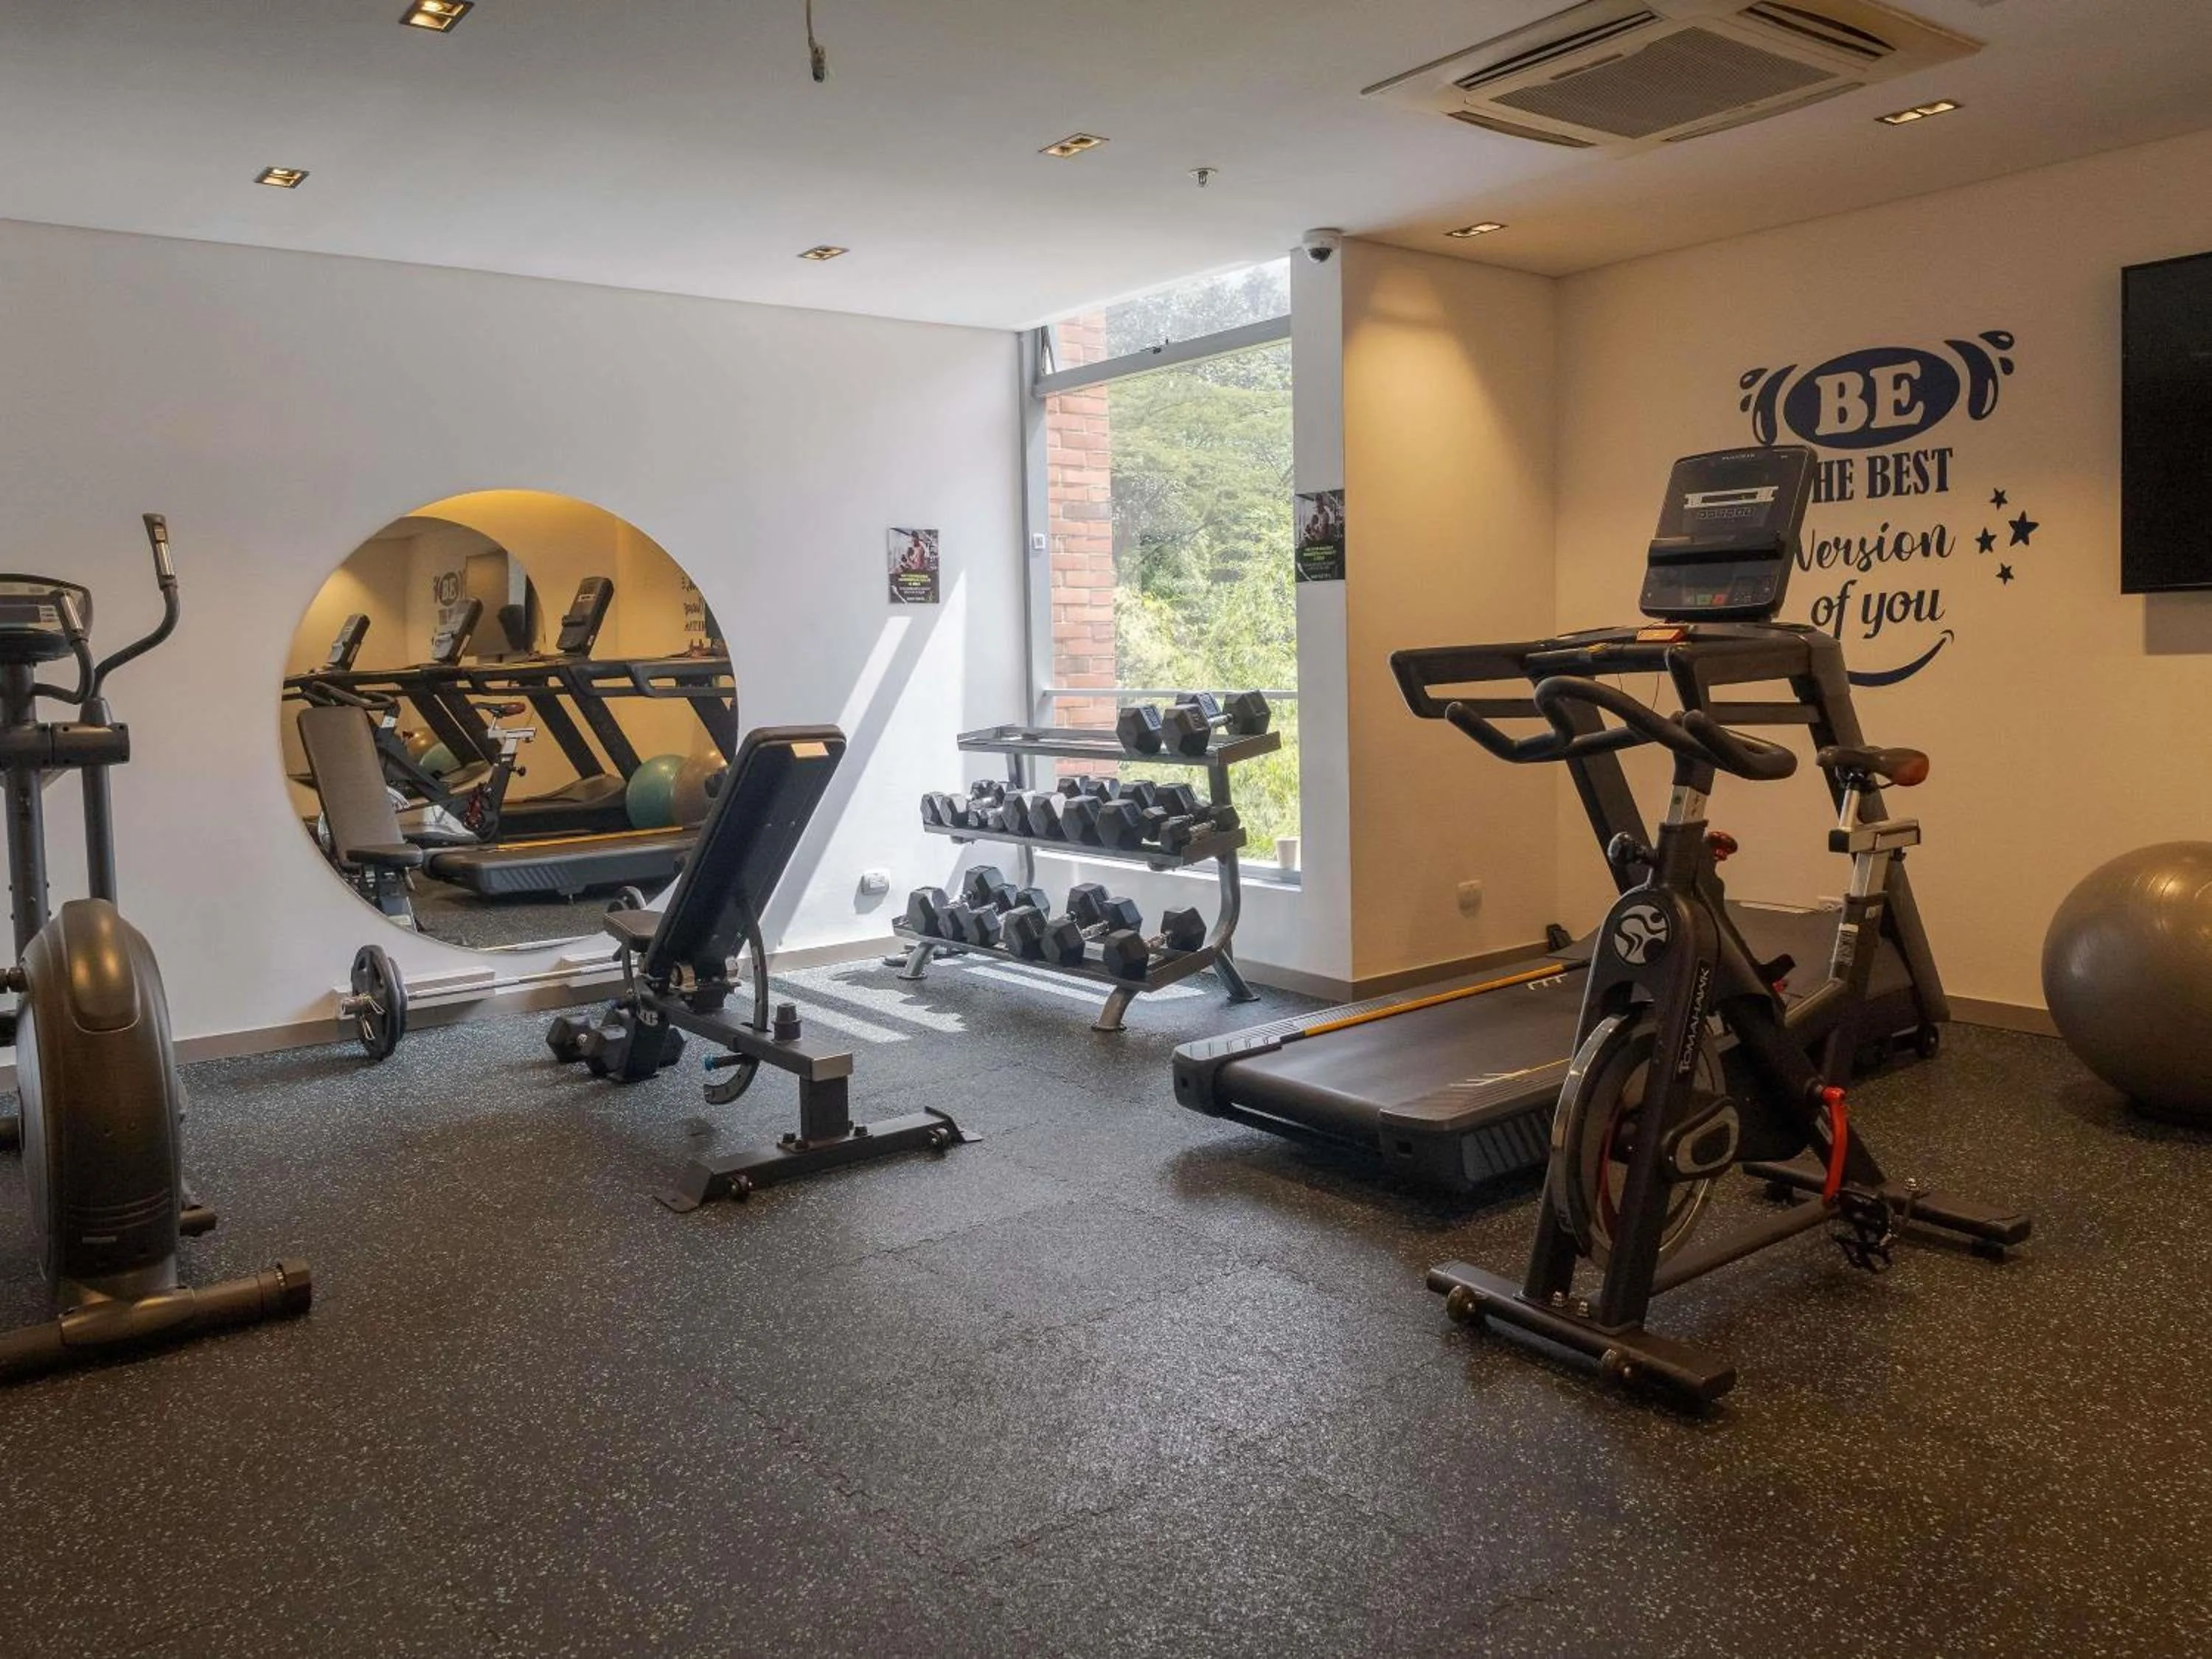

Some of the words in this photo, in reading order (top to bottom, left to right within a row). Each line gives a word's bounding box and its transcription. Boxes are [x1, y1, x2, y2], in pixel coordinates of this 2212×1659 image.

[1815, 360, 1924, 436] BE
[1812, 459, 1854, 504] HE
[1866, 448, 1953, 498] BEST
[1811, 580, 1857, 640] of
[1861, 589, 1945, 639] you
[1679, 968, 1709, 1071] TOMAHAWK
